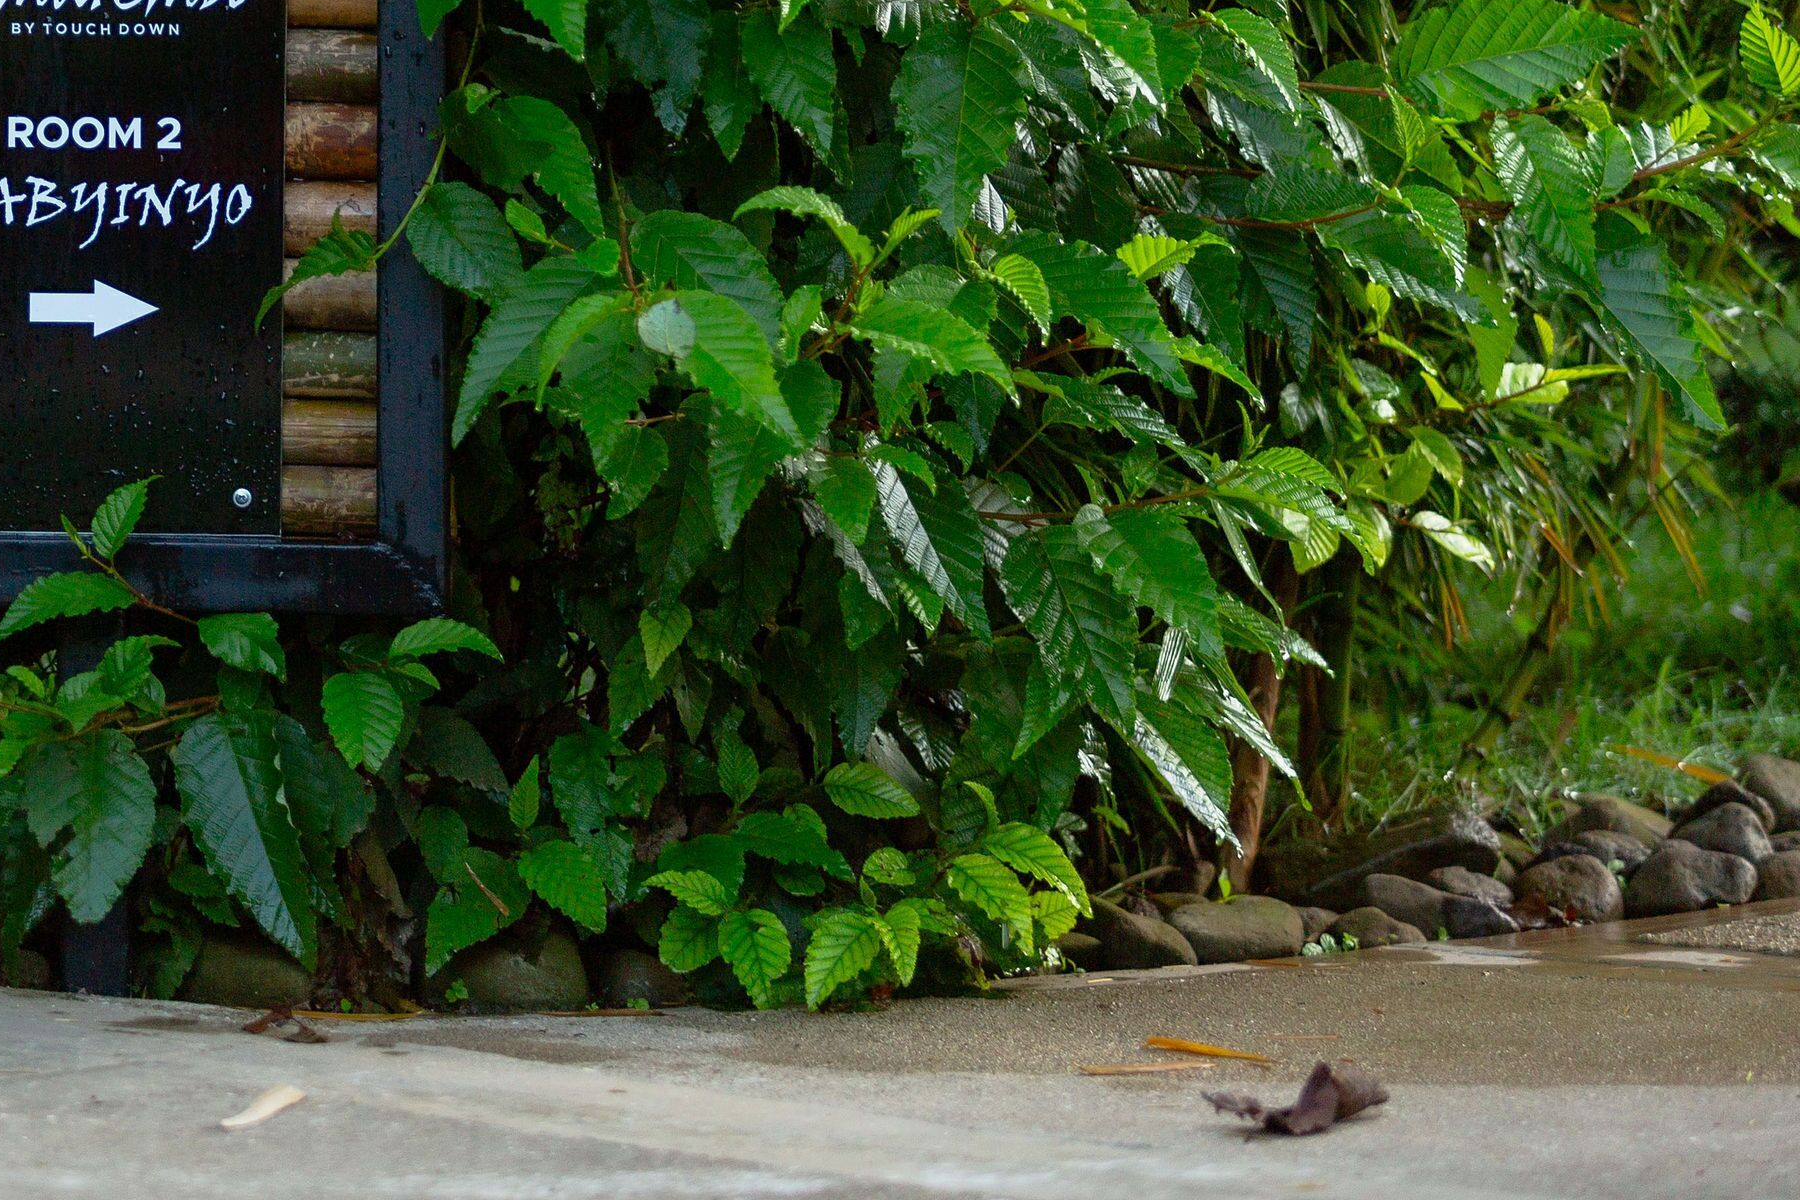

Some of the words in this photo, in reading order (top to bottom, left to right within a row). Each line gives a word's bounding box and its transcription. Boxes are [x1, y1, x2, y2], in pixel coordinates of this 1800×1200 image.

[11, 22, 35, 35] BY
[7, 116, 142, 149] ROOM
[156, 117, 182, 149] 2
